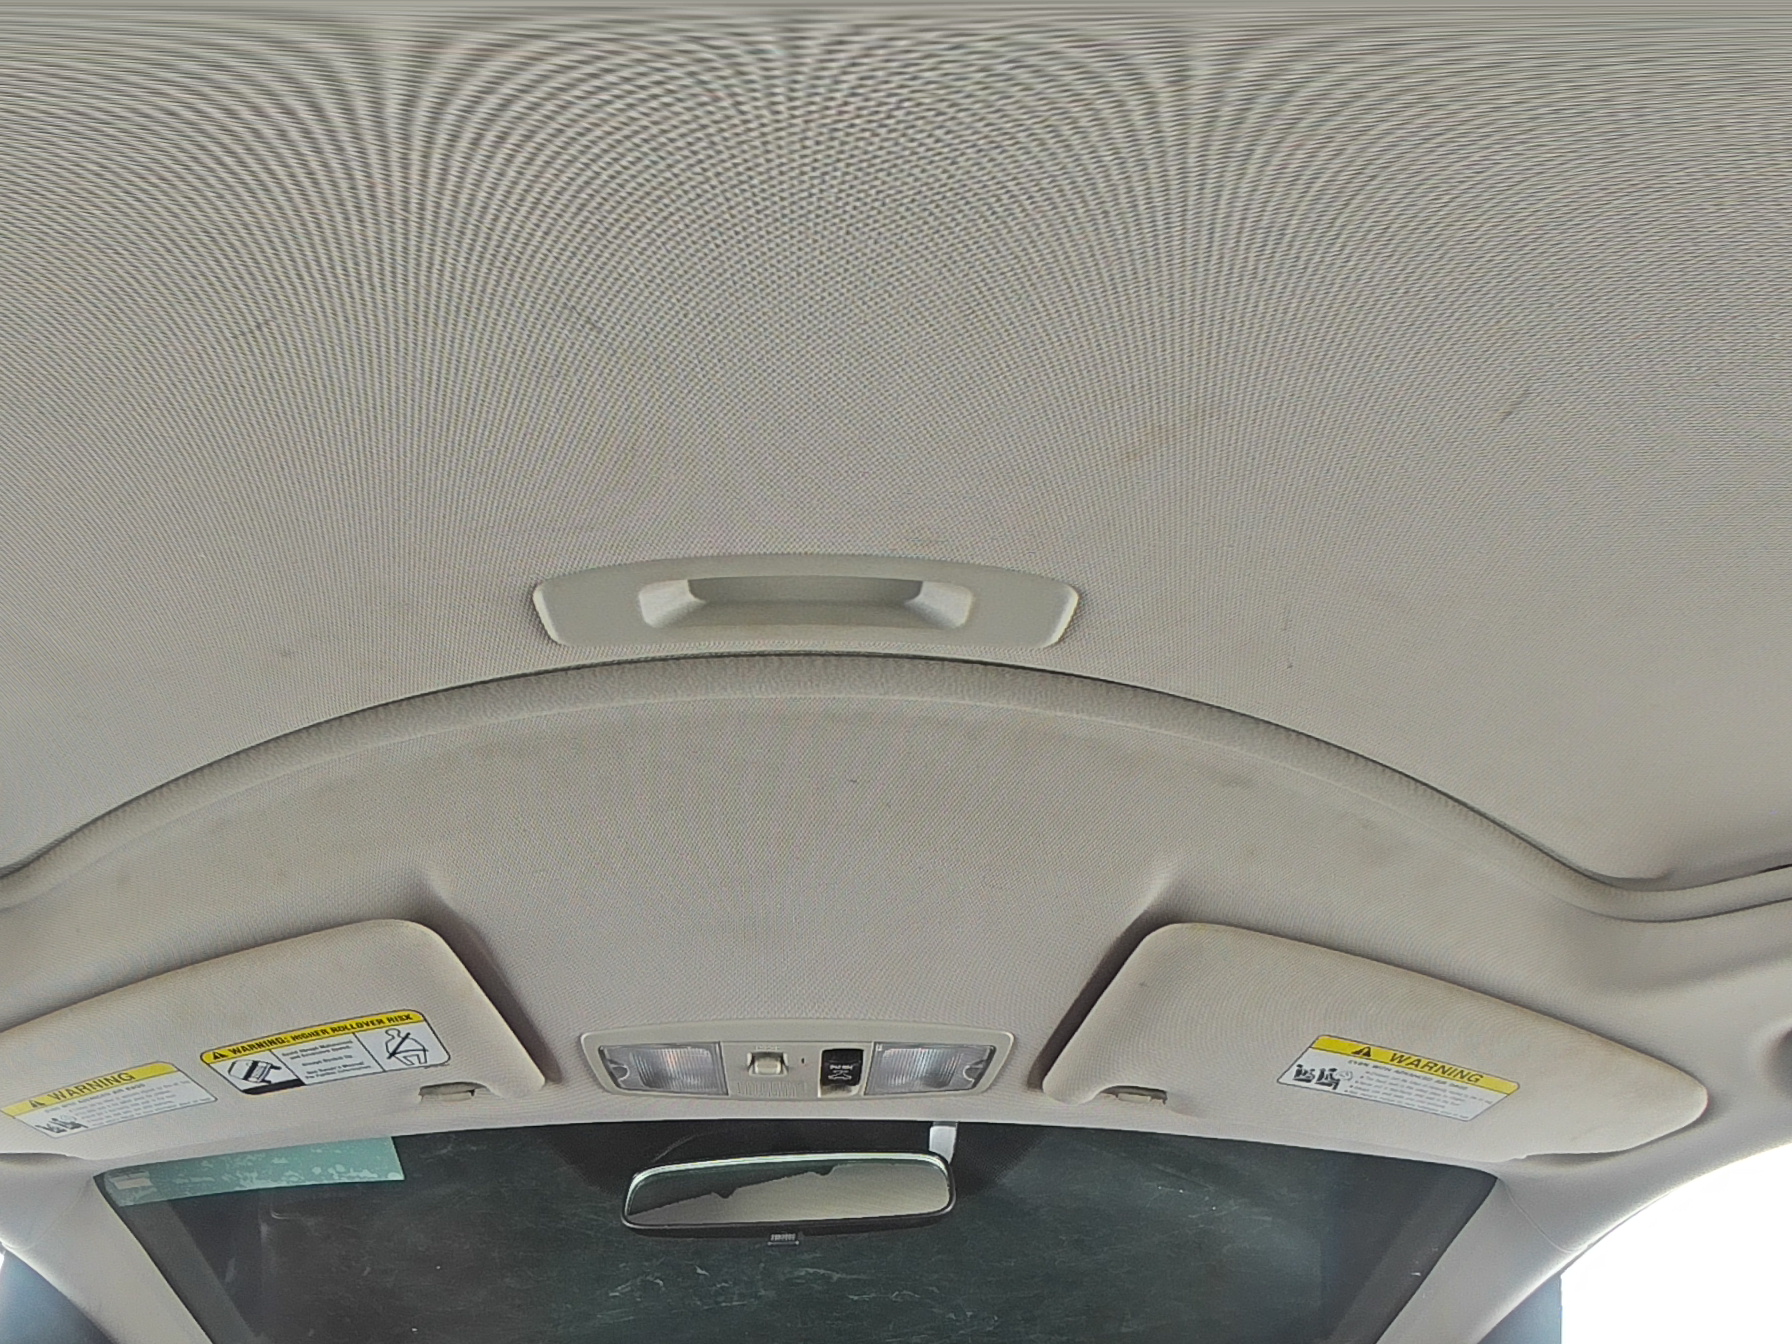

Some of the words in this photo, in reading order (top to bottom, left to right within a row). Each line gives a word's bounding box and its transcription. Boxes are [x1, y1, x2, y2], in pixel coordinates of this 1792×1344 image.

[228, 1036, 289, 1055] WARNING:
[290, 1029, 329, 1042] HIGHER
[329, 1018, 386, 1034] ROLLOVER
[386, 1013, 413, 1023] RISK
[1389, 1052, 1484, 1084] WARNING
[47, 1072, 136, 1101] WARNING
